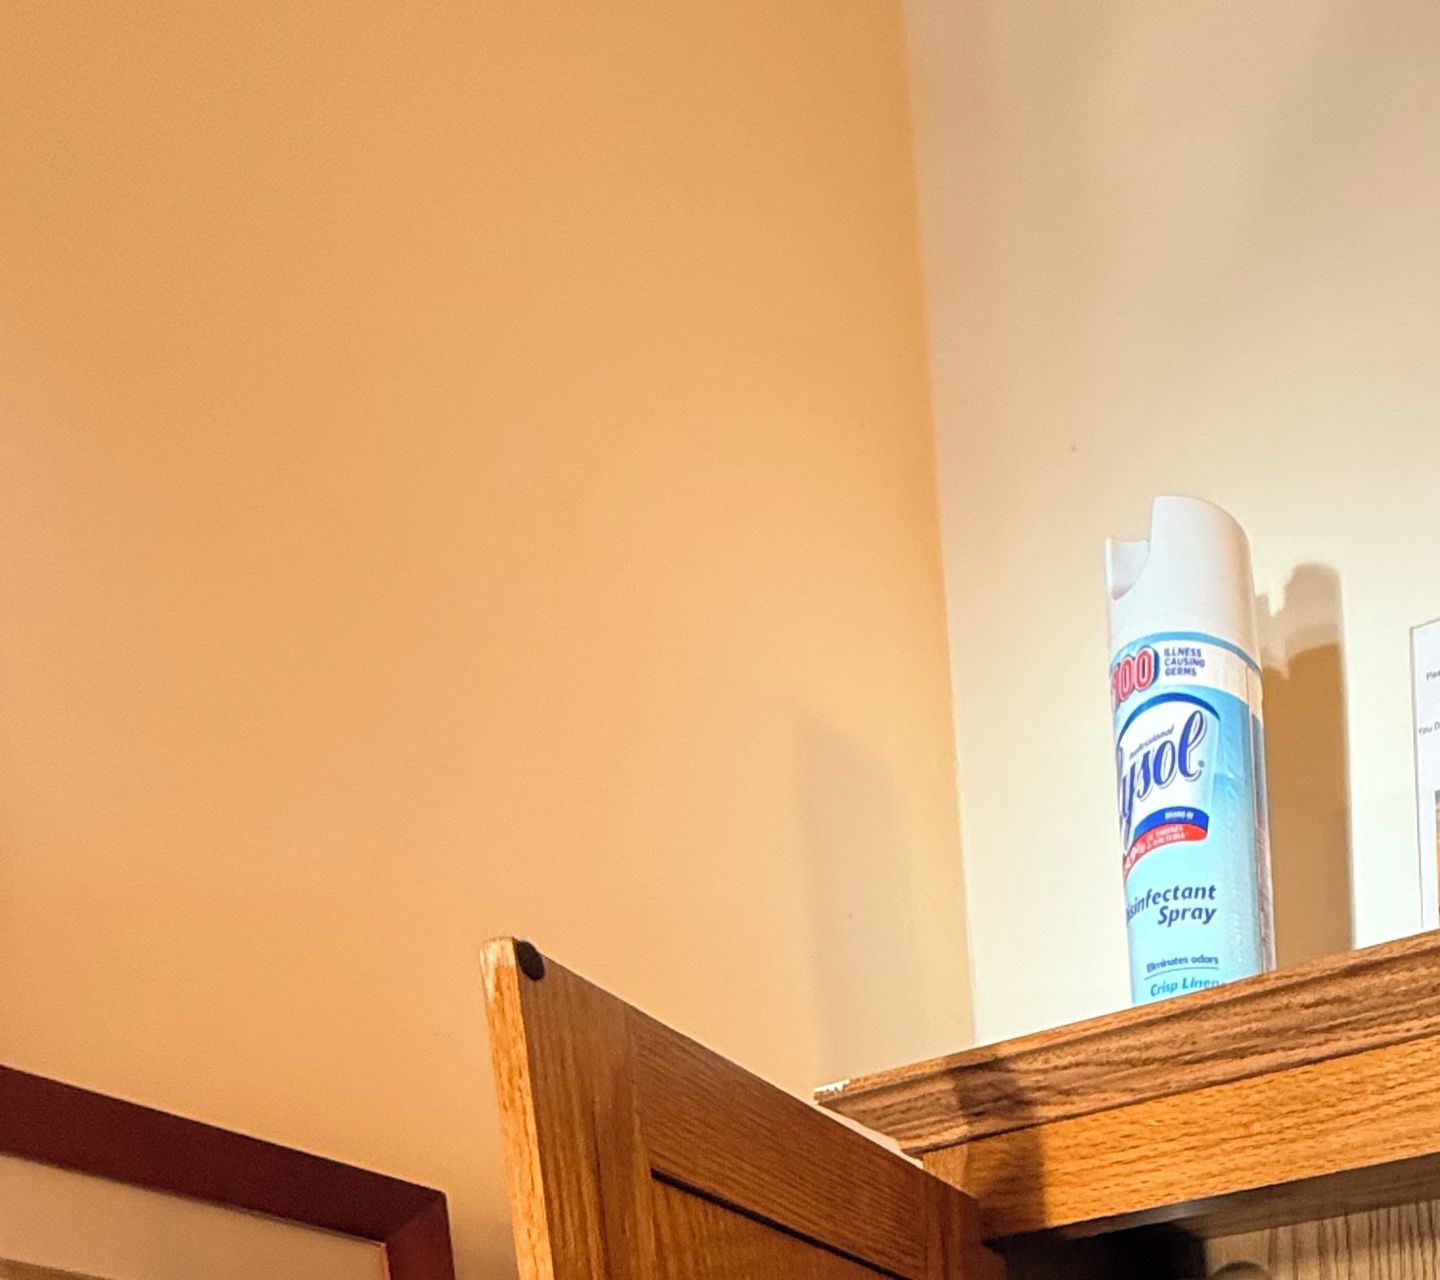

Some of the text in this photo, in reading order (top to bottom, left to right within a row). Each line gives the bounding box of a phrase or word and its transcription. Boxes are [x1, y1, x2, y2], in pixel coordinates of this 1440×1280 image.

[1164, 647, 1201, 657] ILLNESS
[1164, 657, 1205, 668] CAUSING
[1165, 667, 1197, 676] GERMS
[1419, 725, 1433, 736] You
[1118, 709, 1206, 850] ysol
[1158, 905, 1217, 927] Spray
[1146, 954, 1219, 973] Eliminates odors
[1151, 980, 1178, 997] Crisp
